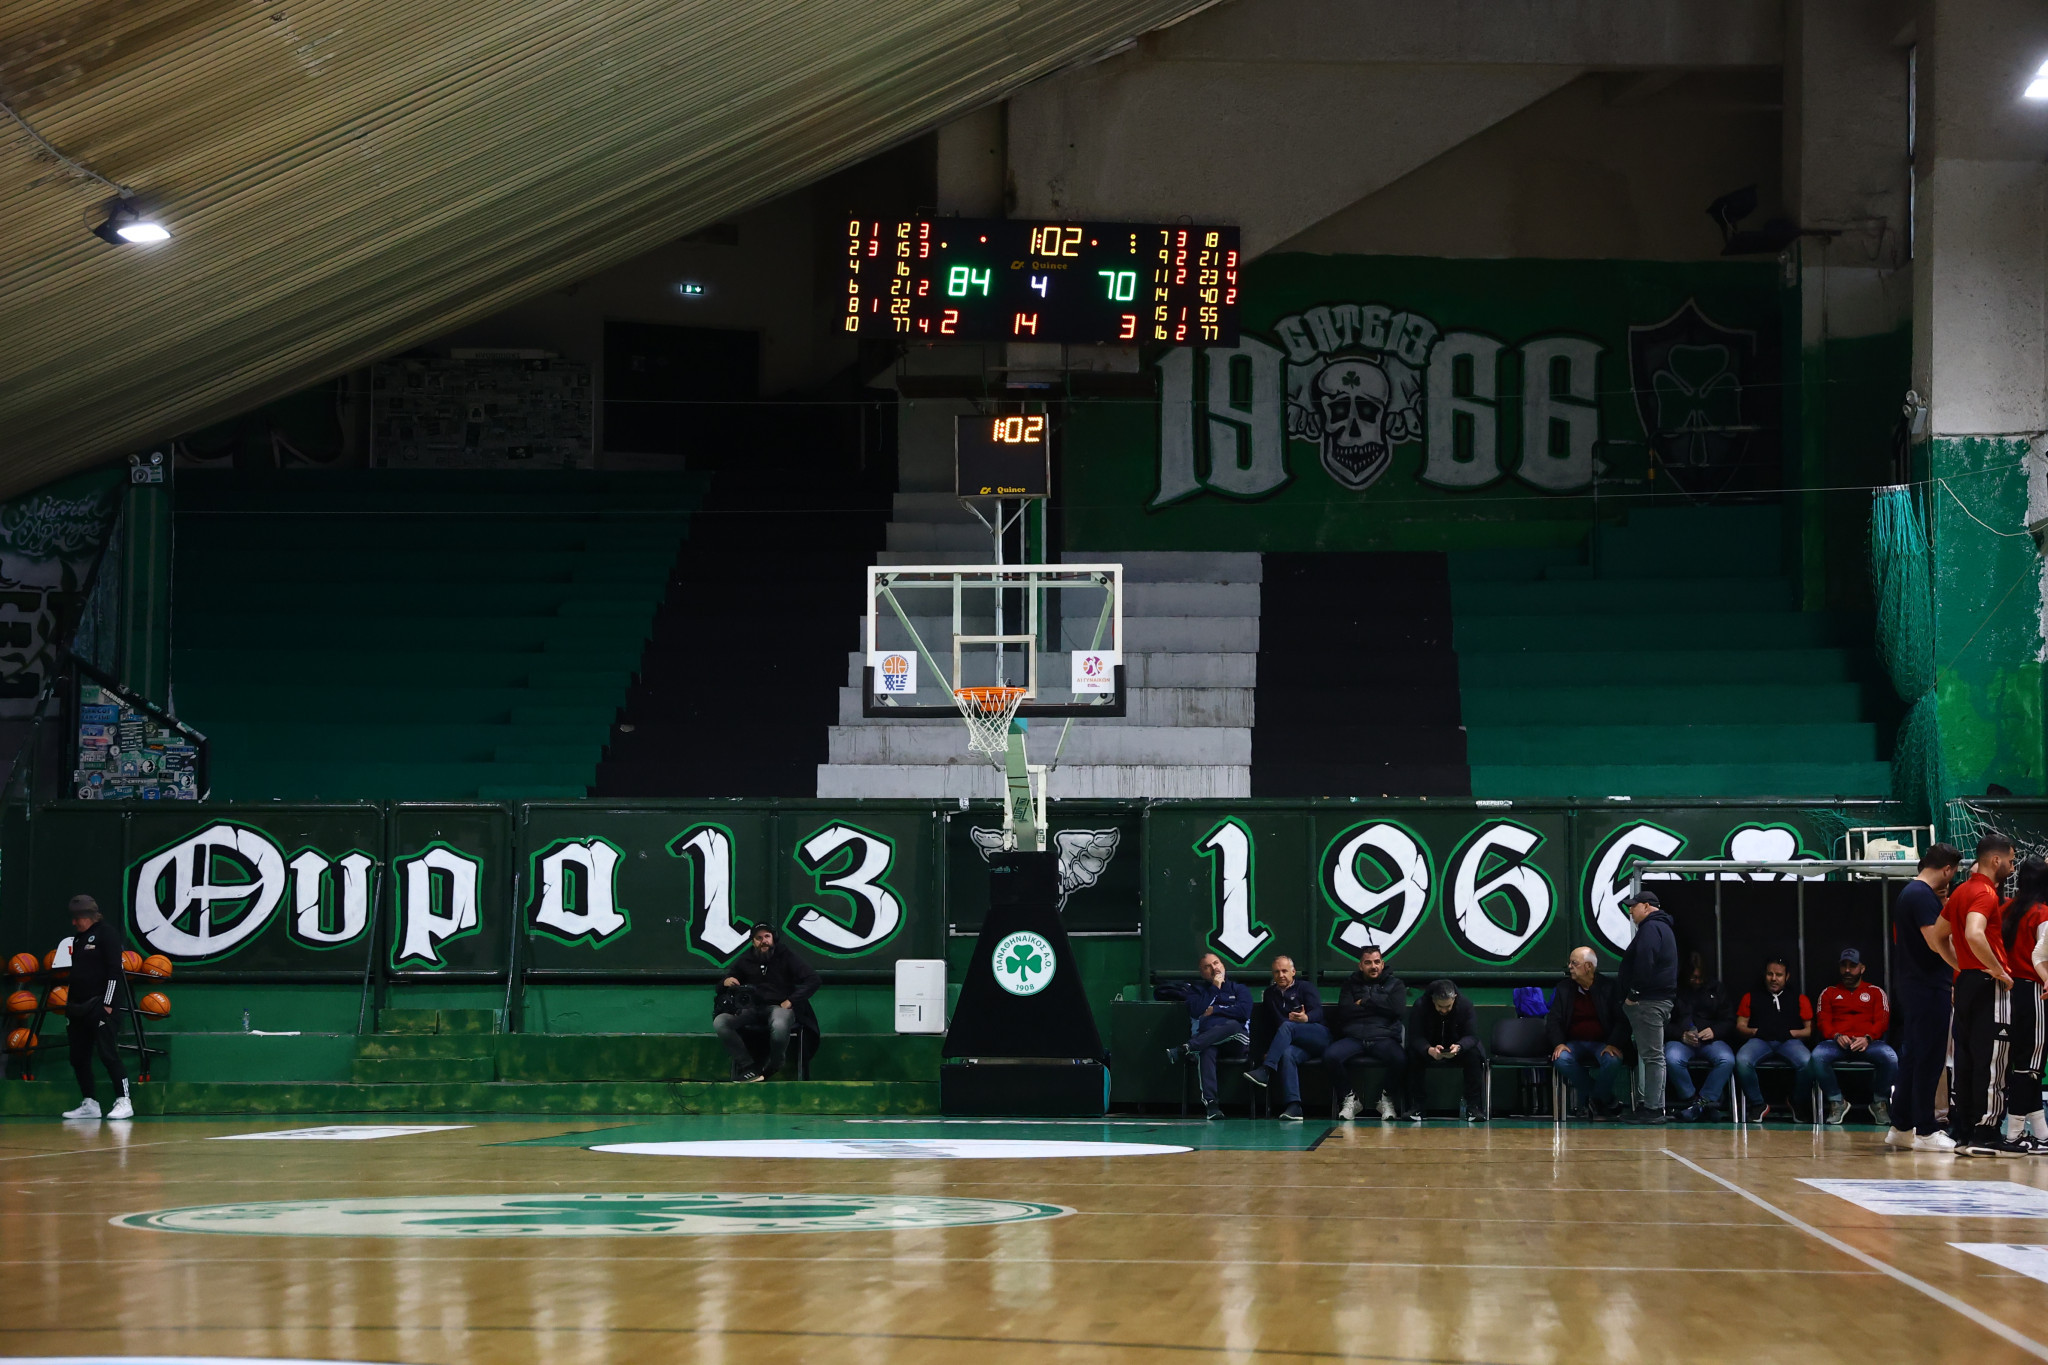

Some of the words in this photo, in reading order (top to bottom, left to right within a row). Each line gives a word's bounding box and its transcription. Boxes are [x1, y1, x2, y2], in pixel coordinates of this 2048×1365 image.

[849, 221, 860, 236] 0
[873, 222, 879, 237] 1
[897, 222, 911, 238] 12
[919, 223, 930, 239] 3
[1160, 230, 1169, 246] 7
[1177, 231, 1187, 247] 3
[1205, 232, 1219, 248] 18
[849, 240, 860, 256] 2
[868, 240, 878, 256] 3
[897, 242, 910, 257] 15
[919, 242, 929, 258] 3
[1030, 227, 1082, 257] 1:02
[1032, 261, 1068, 271] Quince
[1159, 249, 1169, 264] 9
[1176, 250, 1187, 266] 2
[1199, 250, 1219, 266] 21
[1227, 251, 1237, 267] 3
[850, 260, 860, 274] 4
[897, 261, 910, 276] 16
[1155, 269, 1169, 283] 11
[1176, 269, 1186, 284] 2
[1199, 269, 1218, 285] 23
[1227, 271, 1236, 285] 4
[849, 279, 859, 294] 6
[890, 279, 911, 295] 21
[919, 280, 929, 296] 2
[948, 266, 991, 297] 84
[1031, 275, 1048, 298] 4
[1098, 271, 1136, 301] 70
[1155, 288, 1168, 302] 14
[1200, 288, 1218, 304] 40
[1226, 289, 1236, 304] 2
[848, 297, 859, 313] 8
[873, 298, 878, 313] 1
[890, 298, 911, 314] 22
[1155, 305, 1168, 321] 15
[1182, 307, 1187, 321] 1
[1200, 306, 1218, 322] 55
[845, 316, 859, 332] 10
[892, 317, 910, 332] 77
[919, 319, 929, 333] 4
[941, 310, 958, 334] 2
[1014, 313, 1037, 335] 14
[1119, 314, 1136, 339] 3
[1155, 325, 1167, 340] 16
[1176, 325, 1186, 341] 2
[1201, 325, 1218, 341] 77
[993, 416, 1043, 443] 1:02
[997, 486, 1026, 494] Quince
[1015, 983, 1035, 991] 1908
